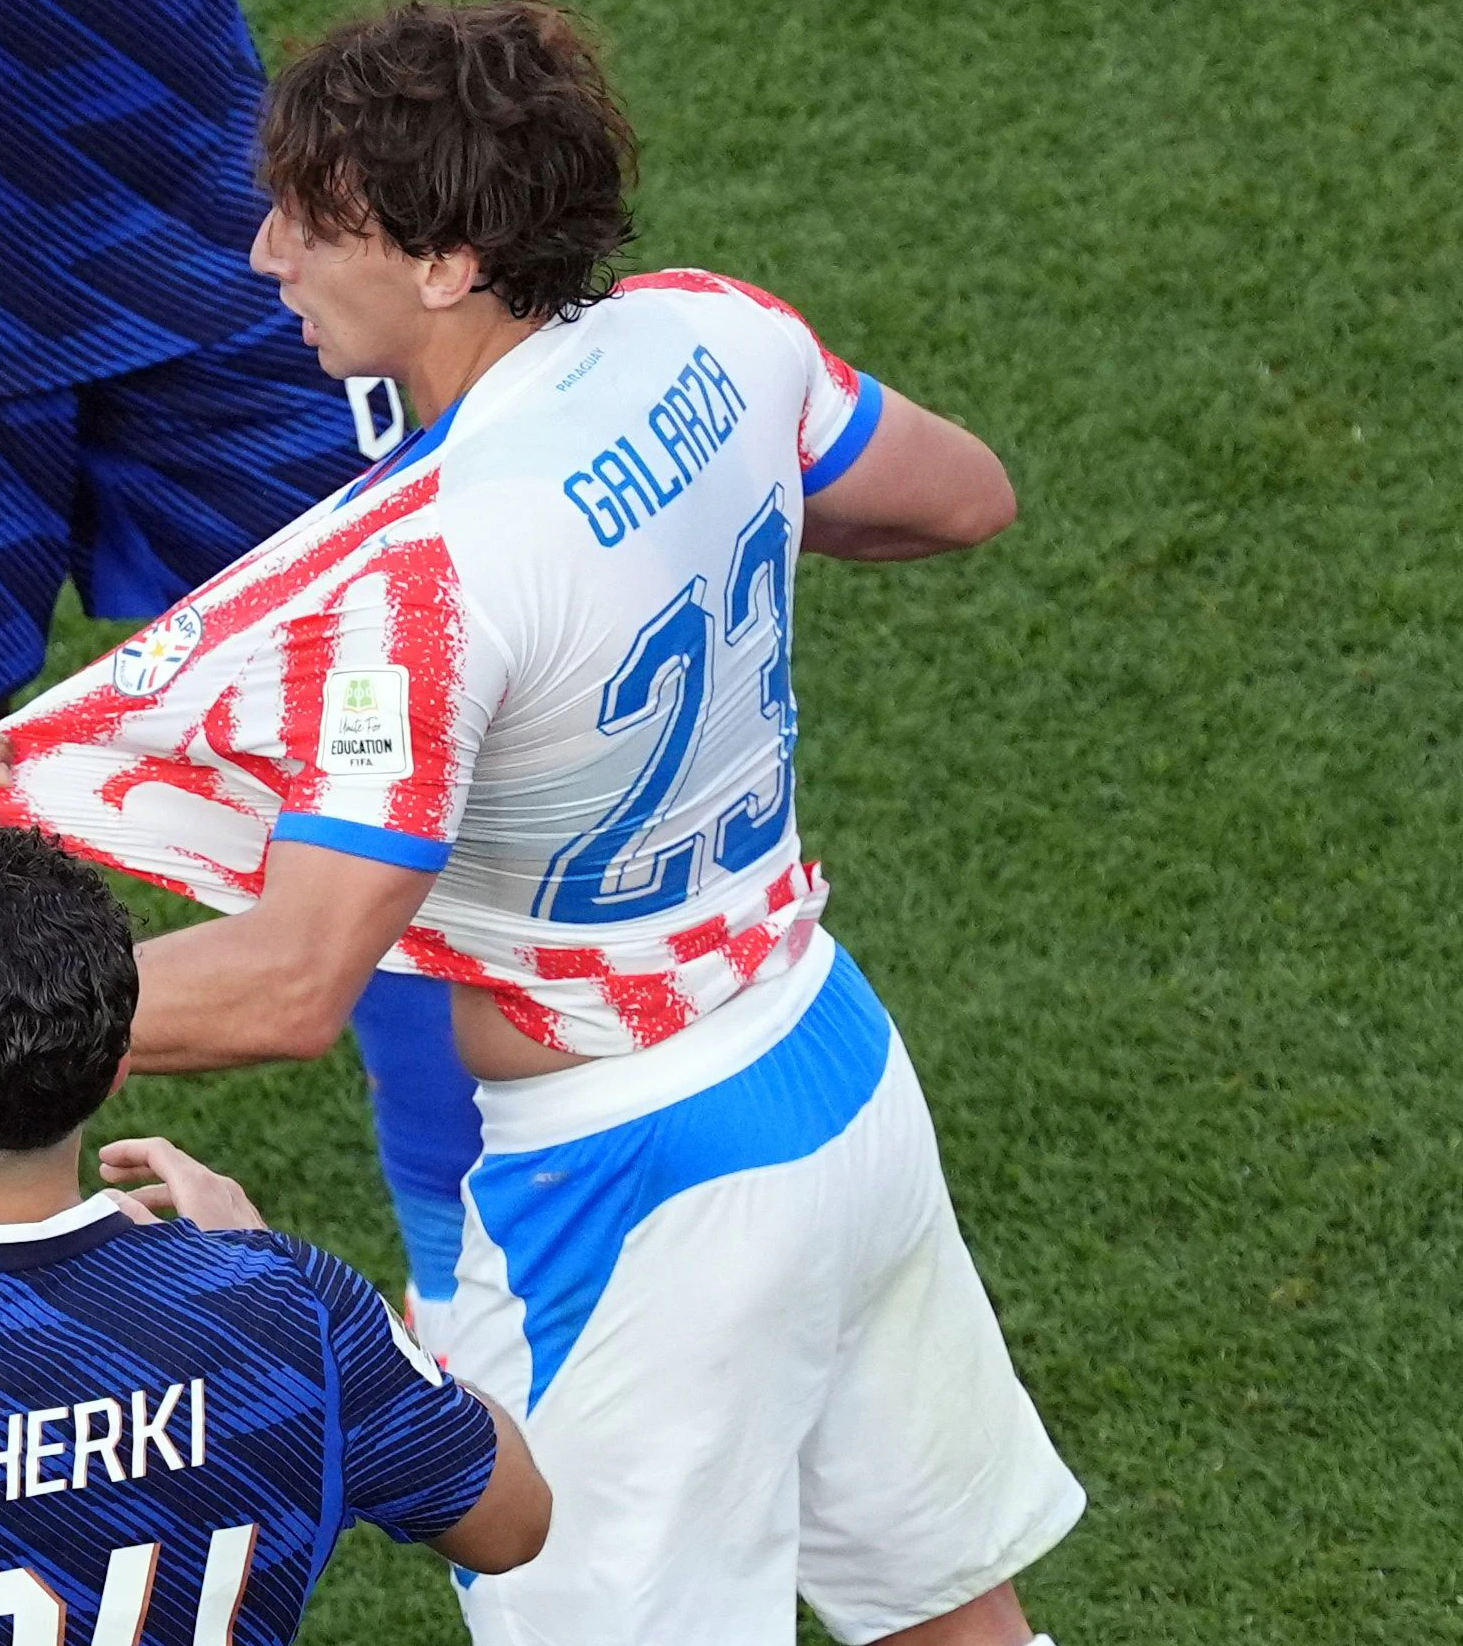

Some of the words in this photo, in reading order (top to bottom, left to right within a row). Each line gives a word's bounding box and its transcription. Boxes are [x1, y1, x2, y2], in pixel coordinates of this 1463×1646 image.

[555, 347, 606, 392] PARAGUAY
[563, 344, 747, 548] GALARZA
[530, 481, 798, 925] 23
[364, 715, 382, 734] For
[331, 738, 393, 755] EDUCATION
[350, 758, 373, 767] FIFA
